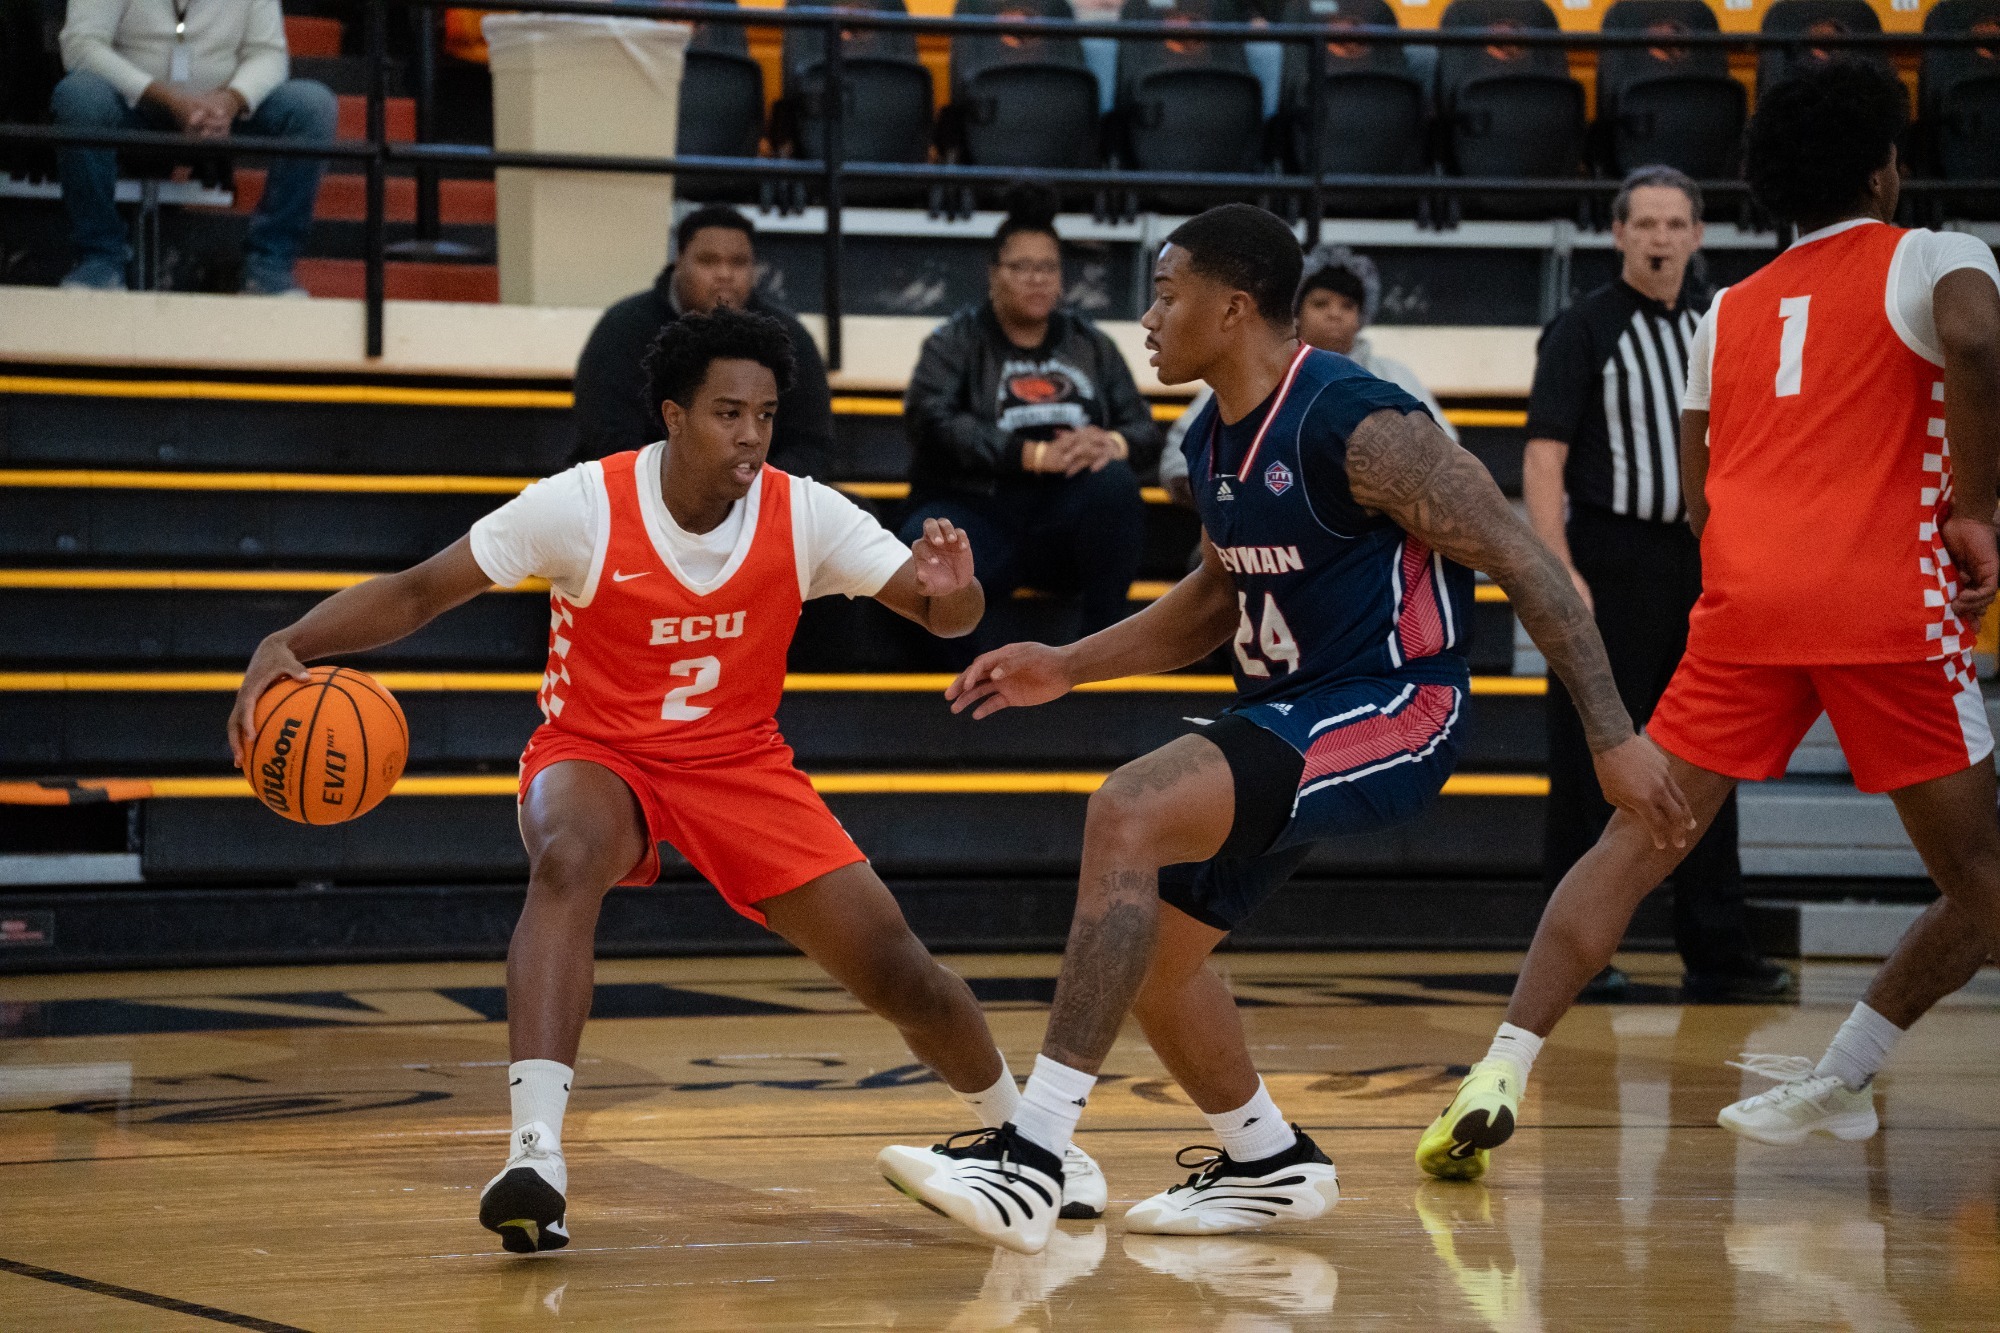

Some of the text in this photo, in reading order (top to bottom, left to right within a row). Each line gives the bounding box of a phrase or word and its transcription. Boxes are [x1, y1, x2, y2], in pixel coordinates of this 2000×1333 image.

[1775, 295, 1811, 397] 1
[649, 610, 747, 645] ECU
[1234, 591, 1300, 677] 24
[661, 655, 721, 721] 2
[261, 718, 302, 812] Wilson
